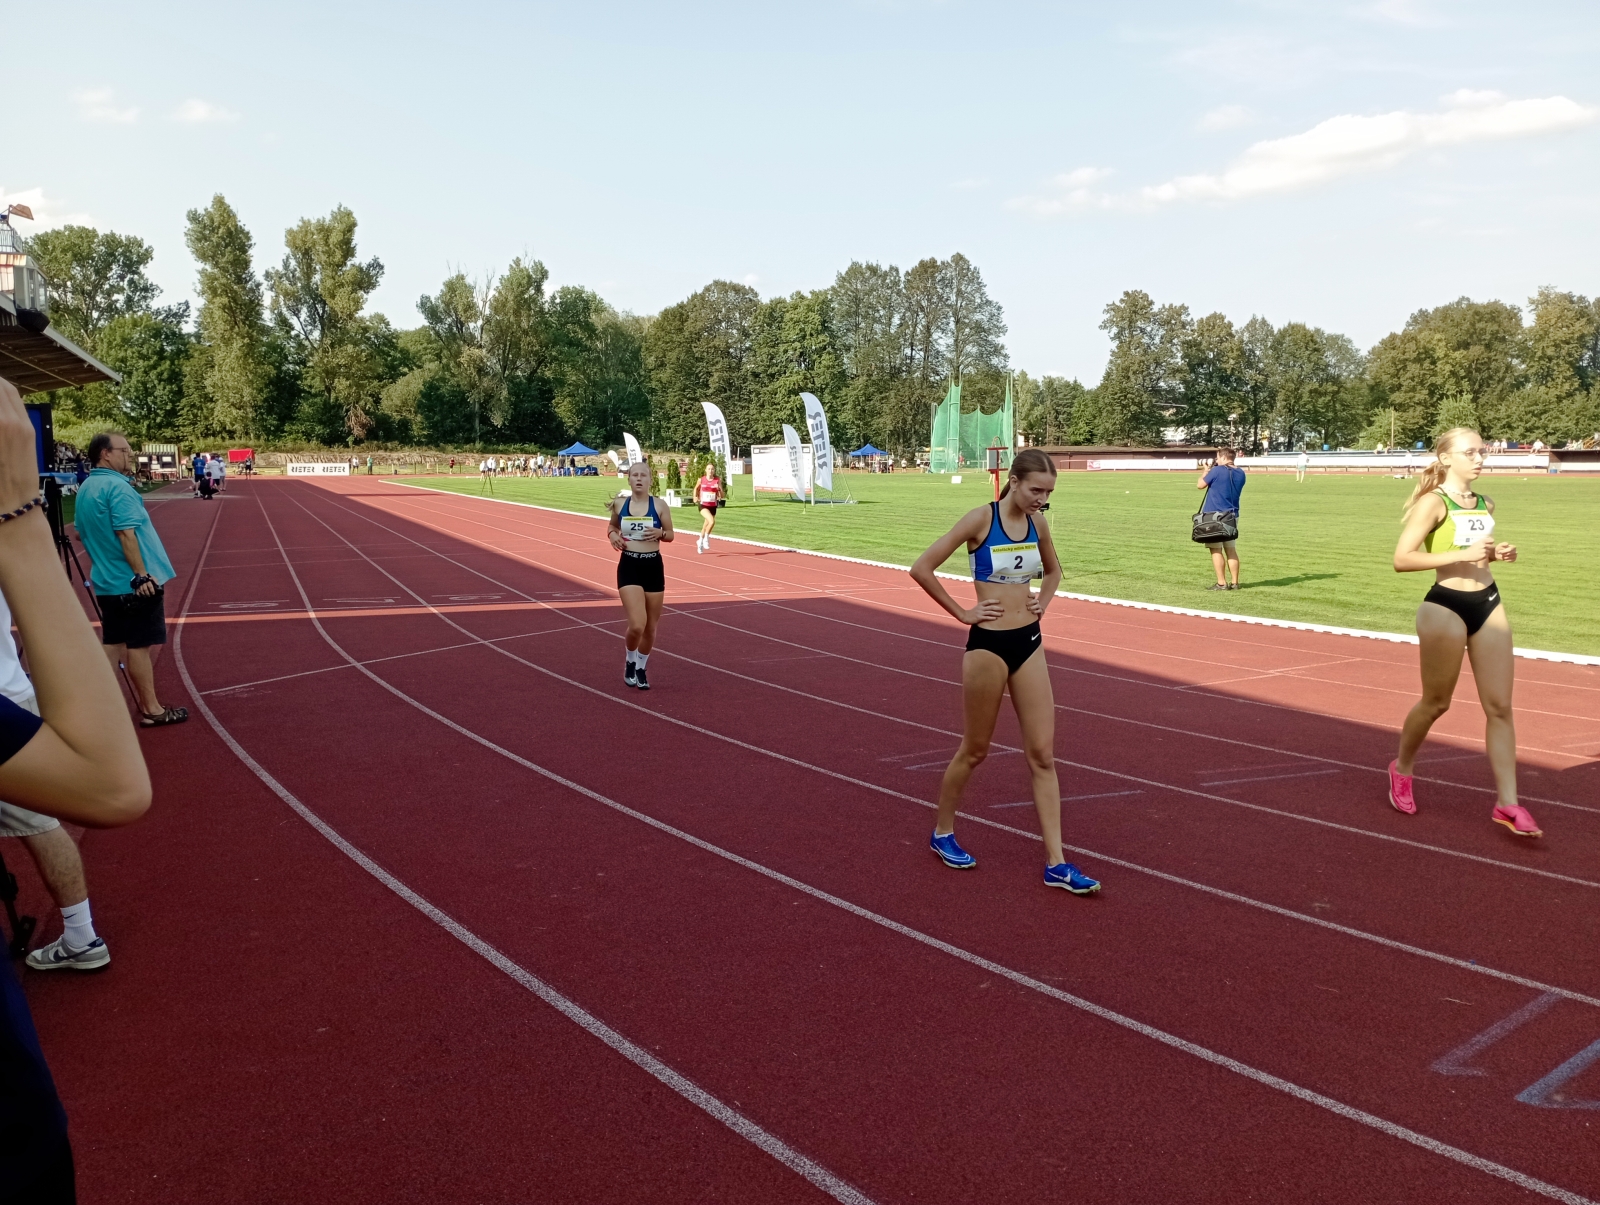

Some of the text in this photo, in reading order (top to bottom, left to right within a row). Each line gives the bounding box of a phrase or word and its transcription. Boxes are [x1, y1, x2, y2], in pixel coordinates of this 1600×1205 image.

[630, 522, 644, 532] 25
[1468, 519, 1485, 531] 23
[1014, 555, 1023, 570] 2
